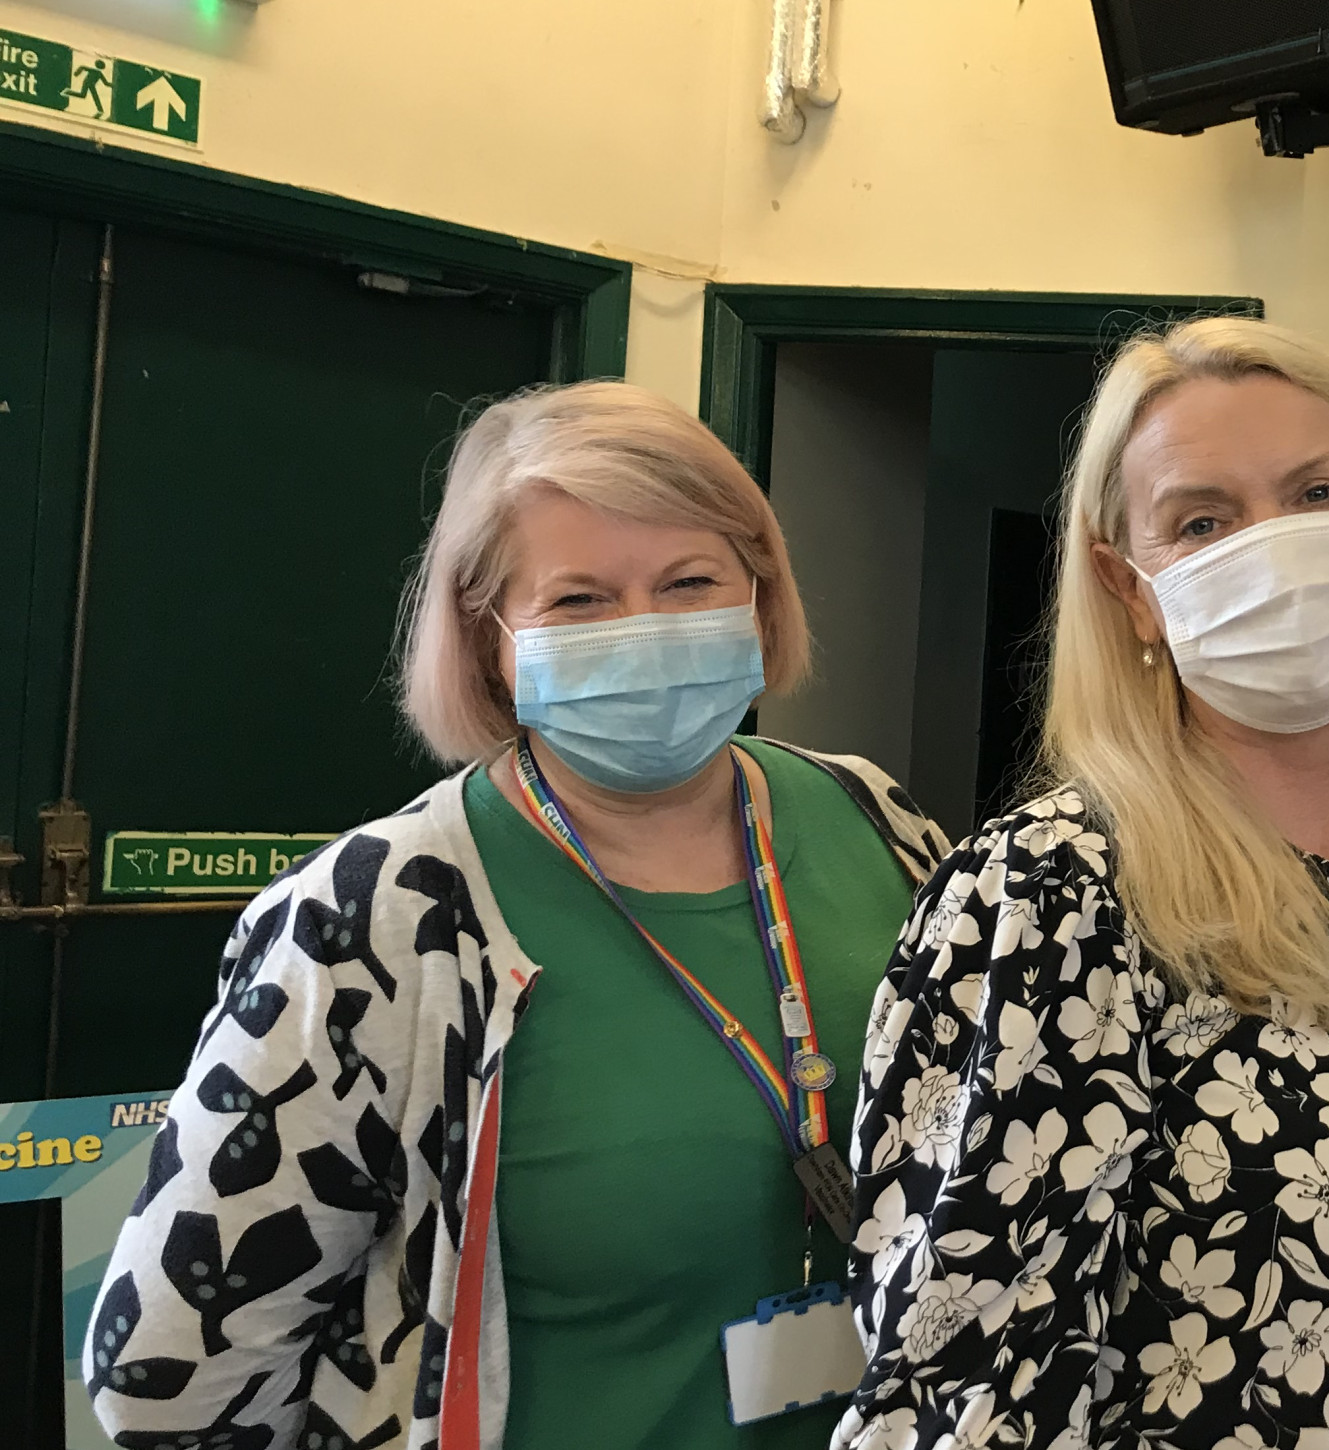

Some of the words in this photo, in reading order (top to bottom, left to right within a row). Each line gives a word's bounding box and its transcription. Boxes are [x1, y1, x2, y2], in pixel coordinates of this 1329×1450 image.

[0, 37, 39, 68] ire
[166, 847, 257, 876] Push
[111, 1102, 170, 1127] NHS
[0, 1131, 103, 1171] cine
